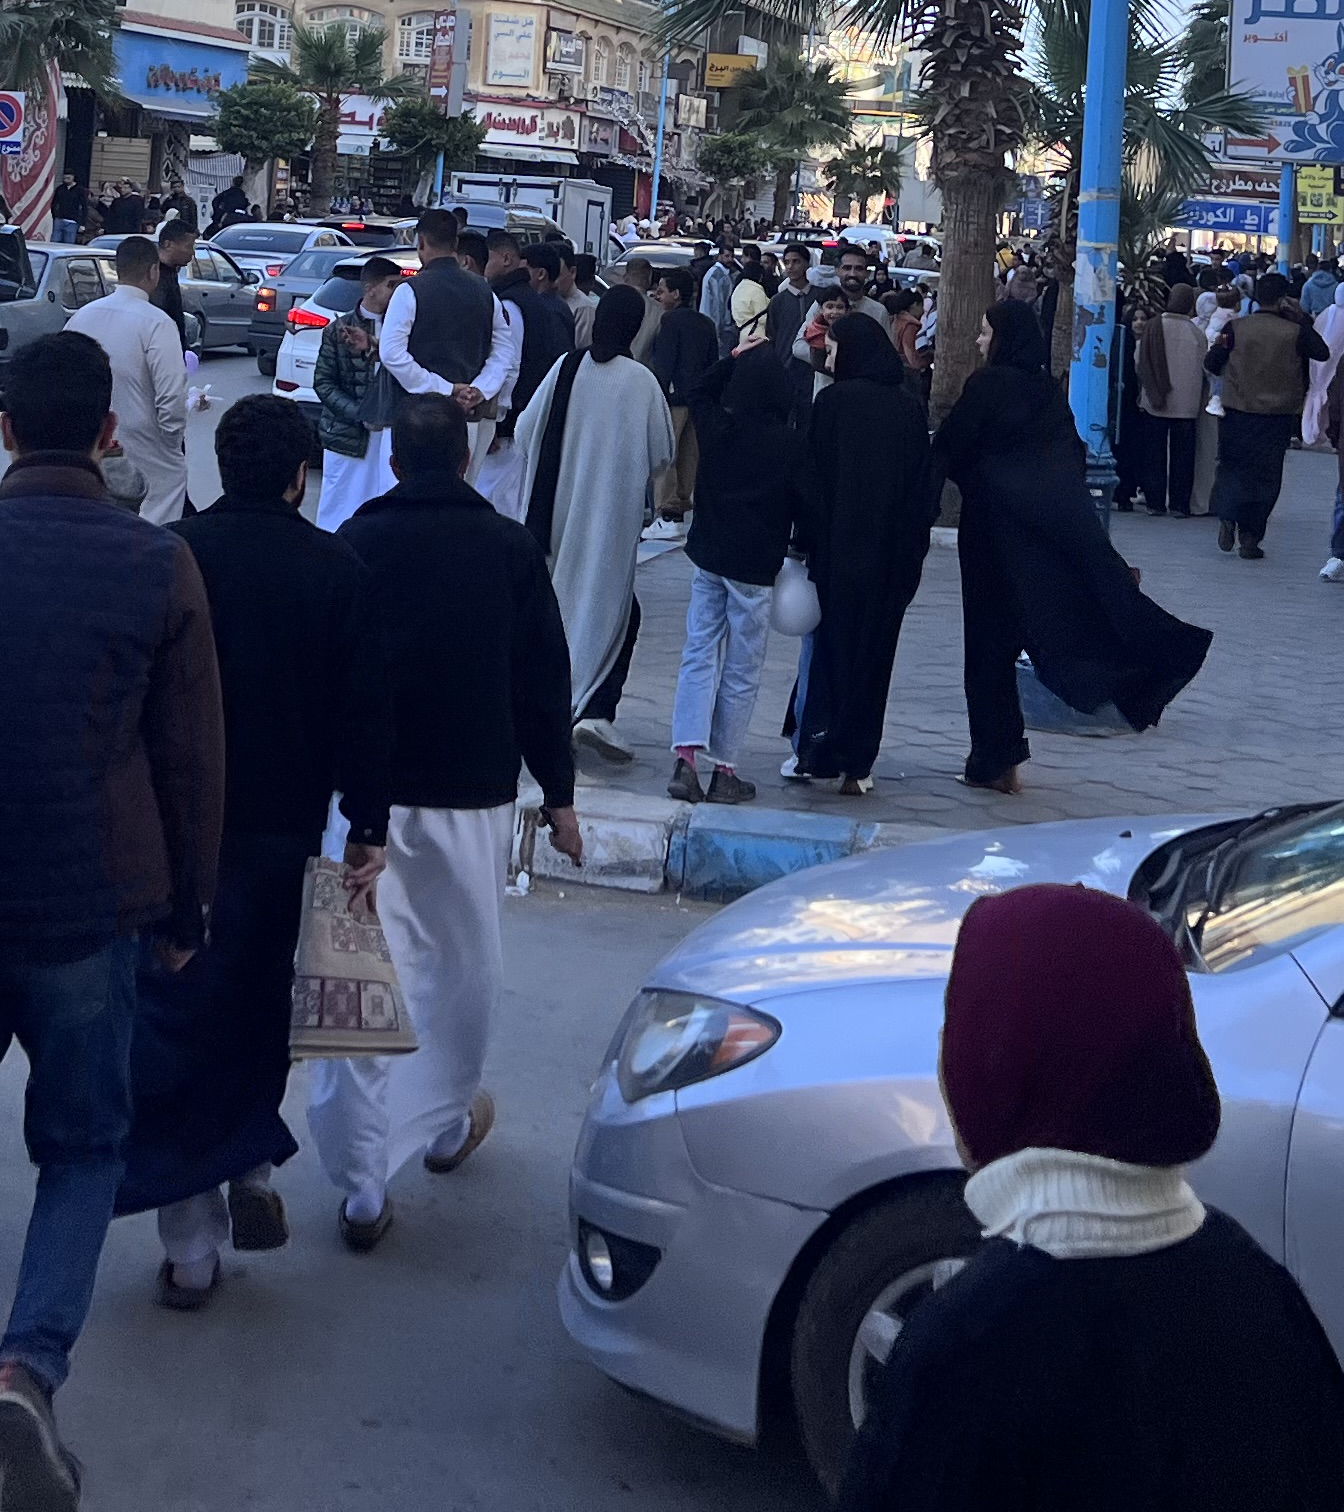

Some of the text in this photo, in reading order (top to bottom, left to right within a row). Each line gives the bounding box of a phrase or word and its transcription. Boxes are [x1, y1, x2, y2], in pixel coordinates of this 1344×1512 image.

[1243, 30, 1288, 43] أكتوبر
[492, 69, 530, 80] اليوم
[1211, 175, 1254, 193] مطروح
[1184, 207, 1235, 225] الكورني
